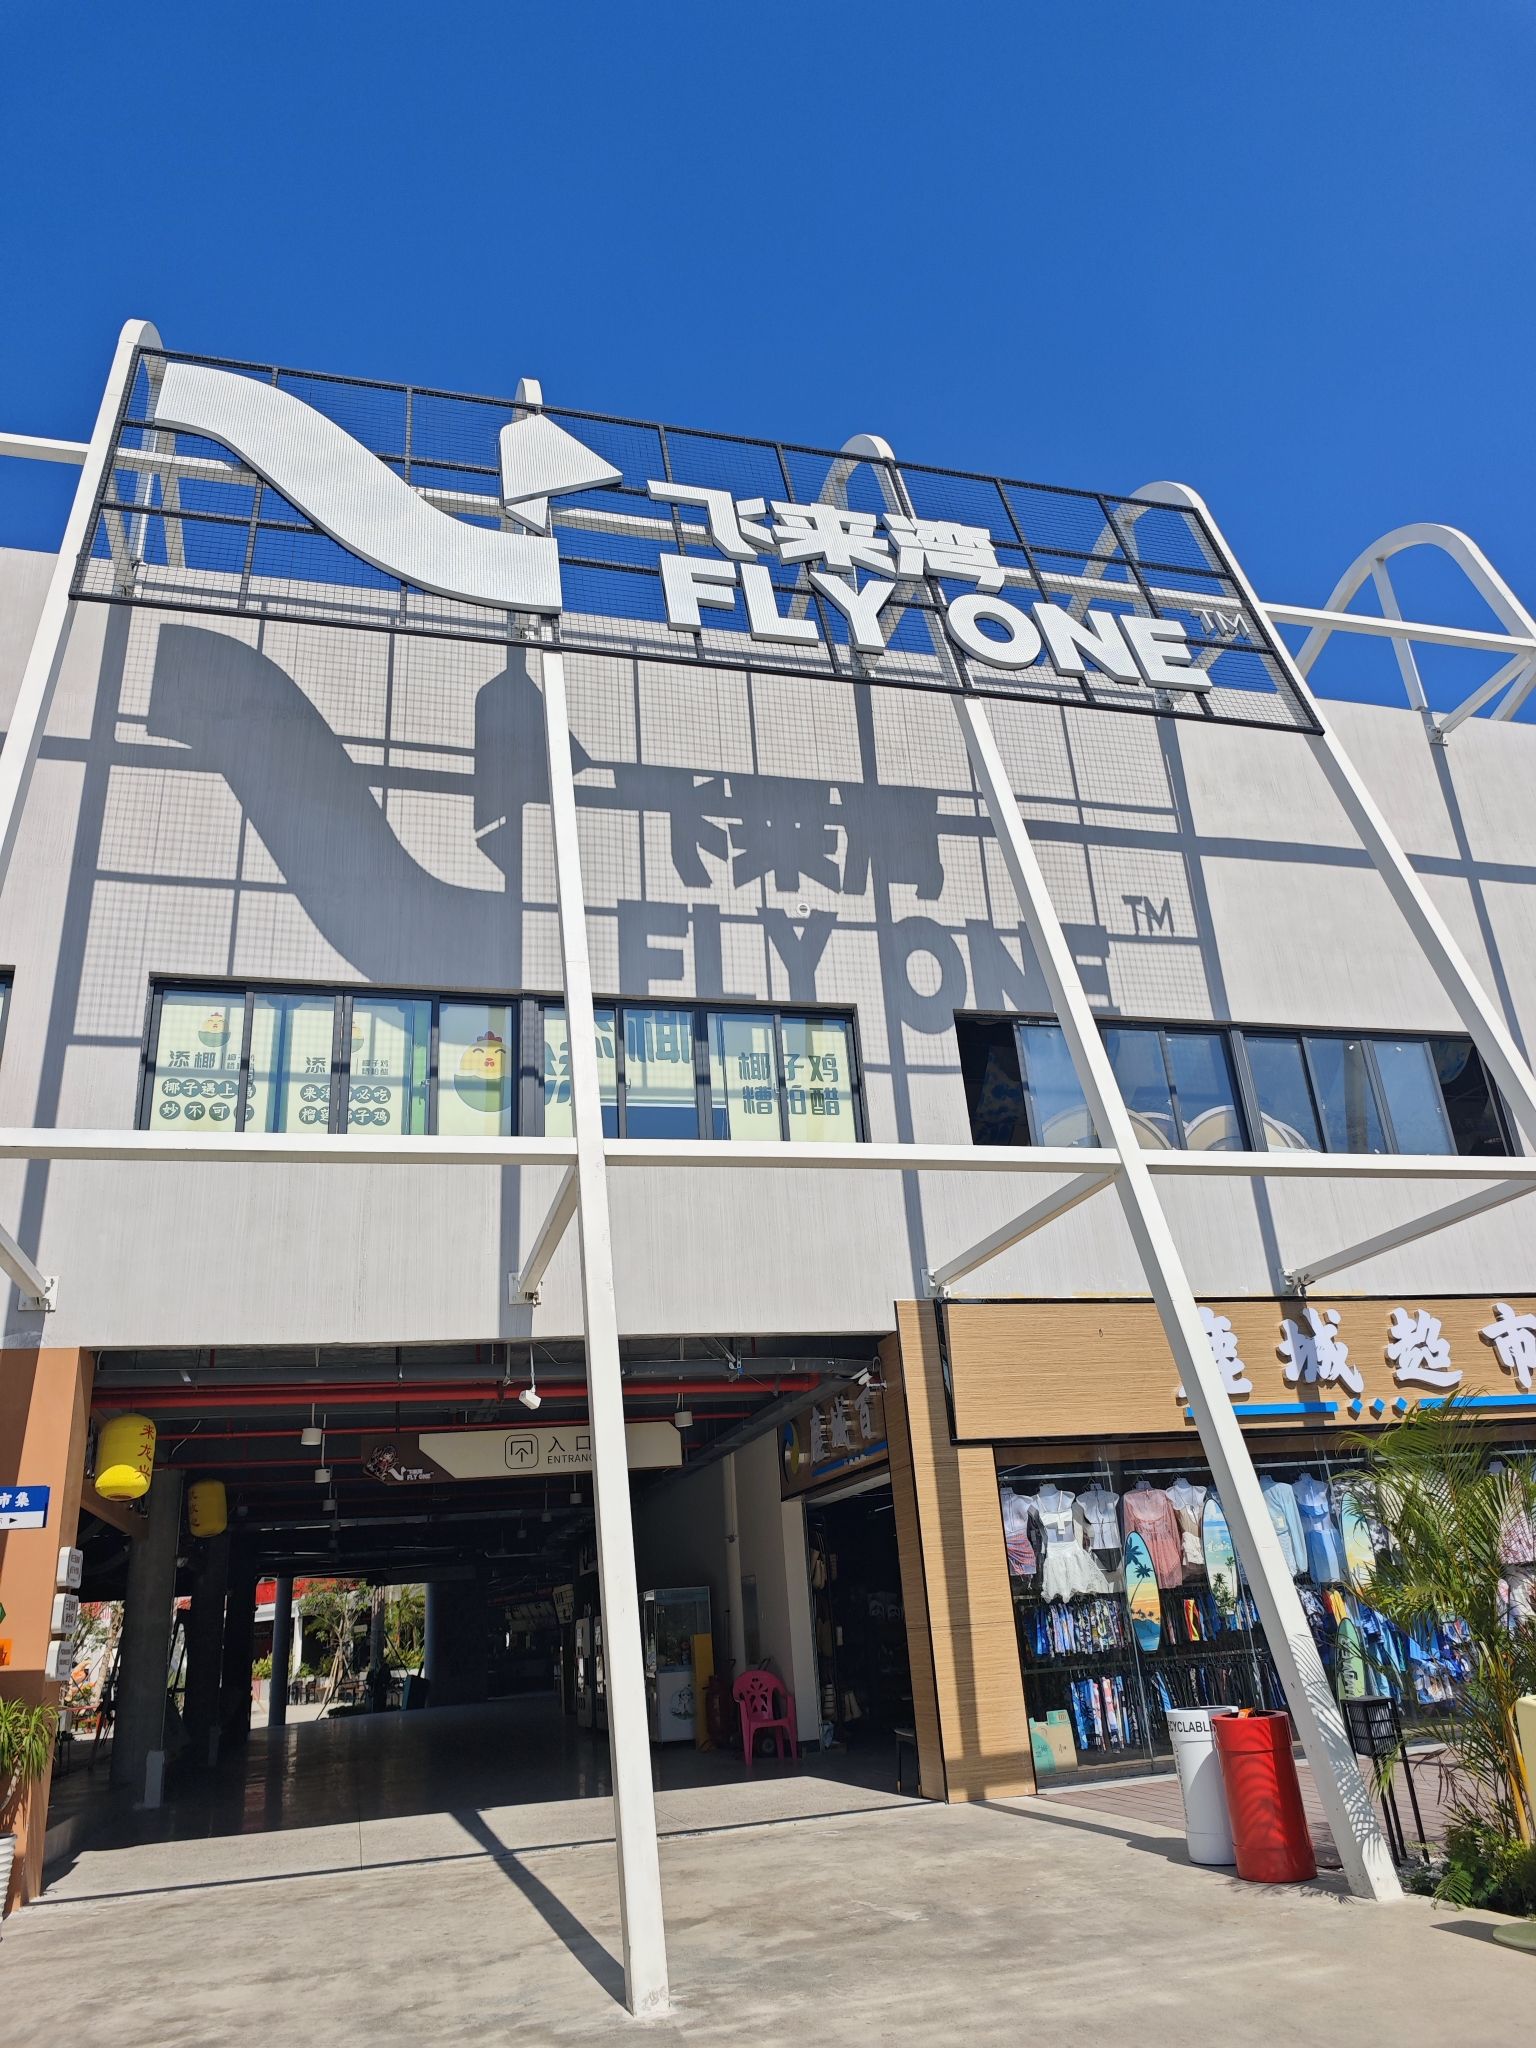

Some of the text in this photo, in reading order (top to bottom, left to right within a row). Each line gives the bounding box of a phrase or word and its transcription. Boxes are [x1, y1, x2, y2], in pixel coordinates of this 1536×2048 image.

[645, 479, 1005, 594] 飞来湾
[658, 553, 896, 655] FLY
[945, 593, 1213, 693] ONE
[168, 1050, 216, 1069] 添椰
[737, 1052, 839, 1082] 椰子鸡
[303, 1086, 389, 1102] 来海必吃
[301, 1108, 388, 1123] 榴莲子鸡
[548, 1436, 591, 1452] 入口
